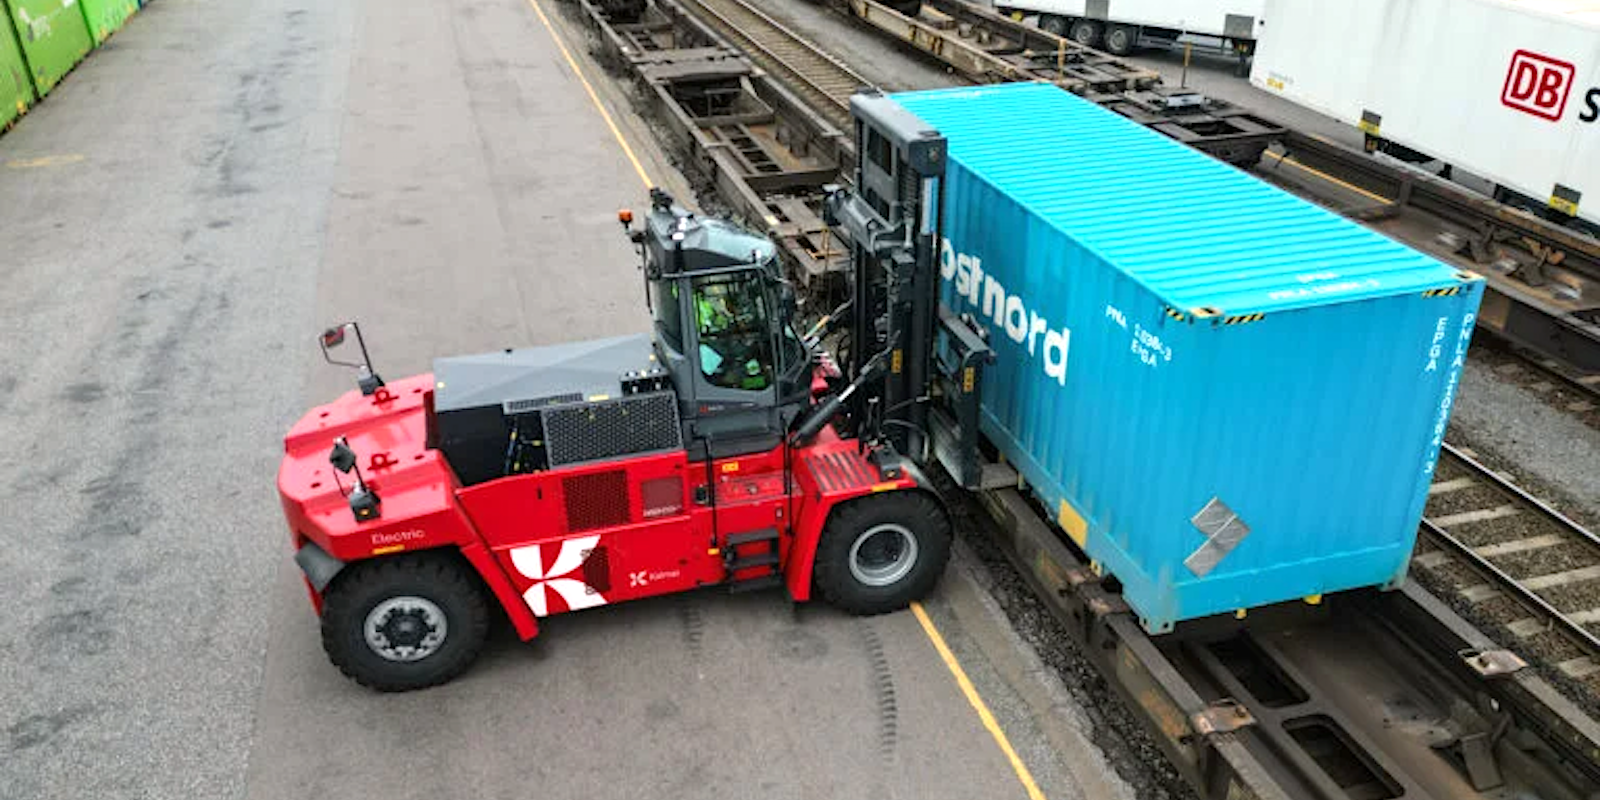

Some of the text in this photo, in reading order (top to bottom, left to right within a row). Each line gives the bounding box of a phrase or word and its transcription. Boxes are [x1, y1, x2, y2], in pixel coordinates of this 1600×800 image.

[1510, 60, 1563, 108] DB
[939, 237, 1071, 386] ostnord
[1424, 316, 1449, 372] EPGA
[371, 530, 426, 545] Electric
